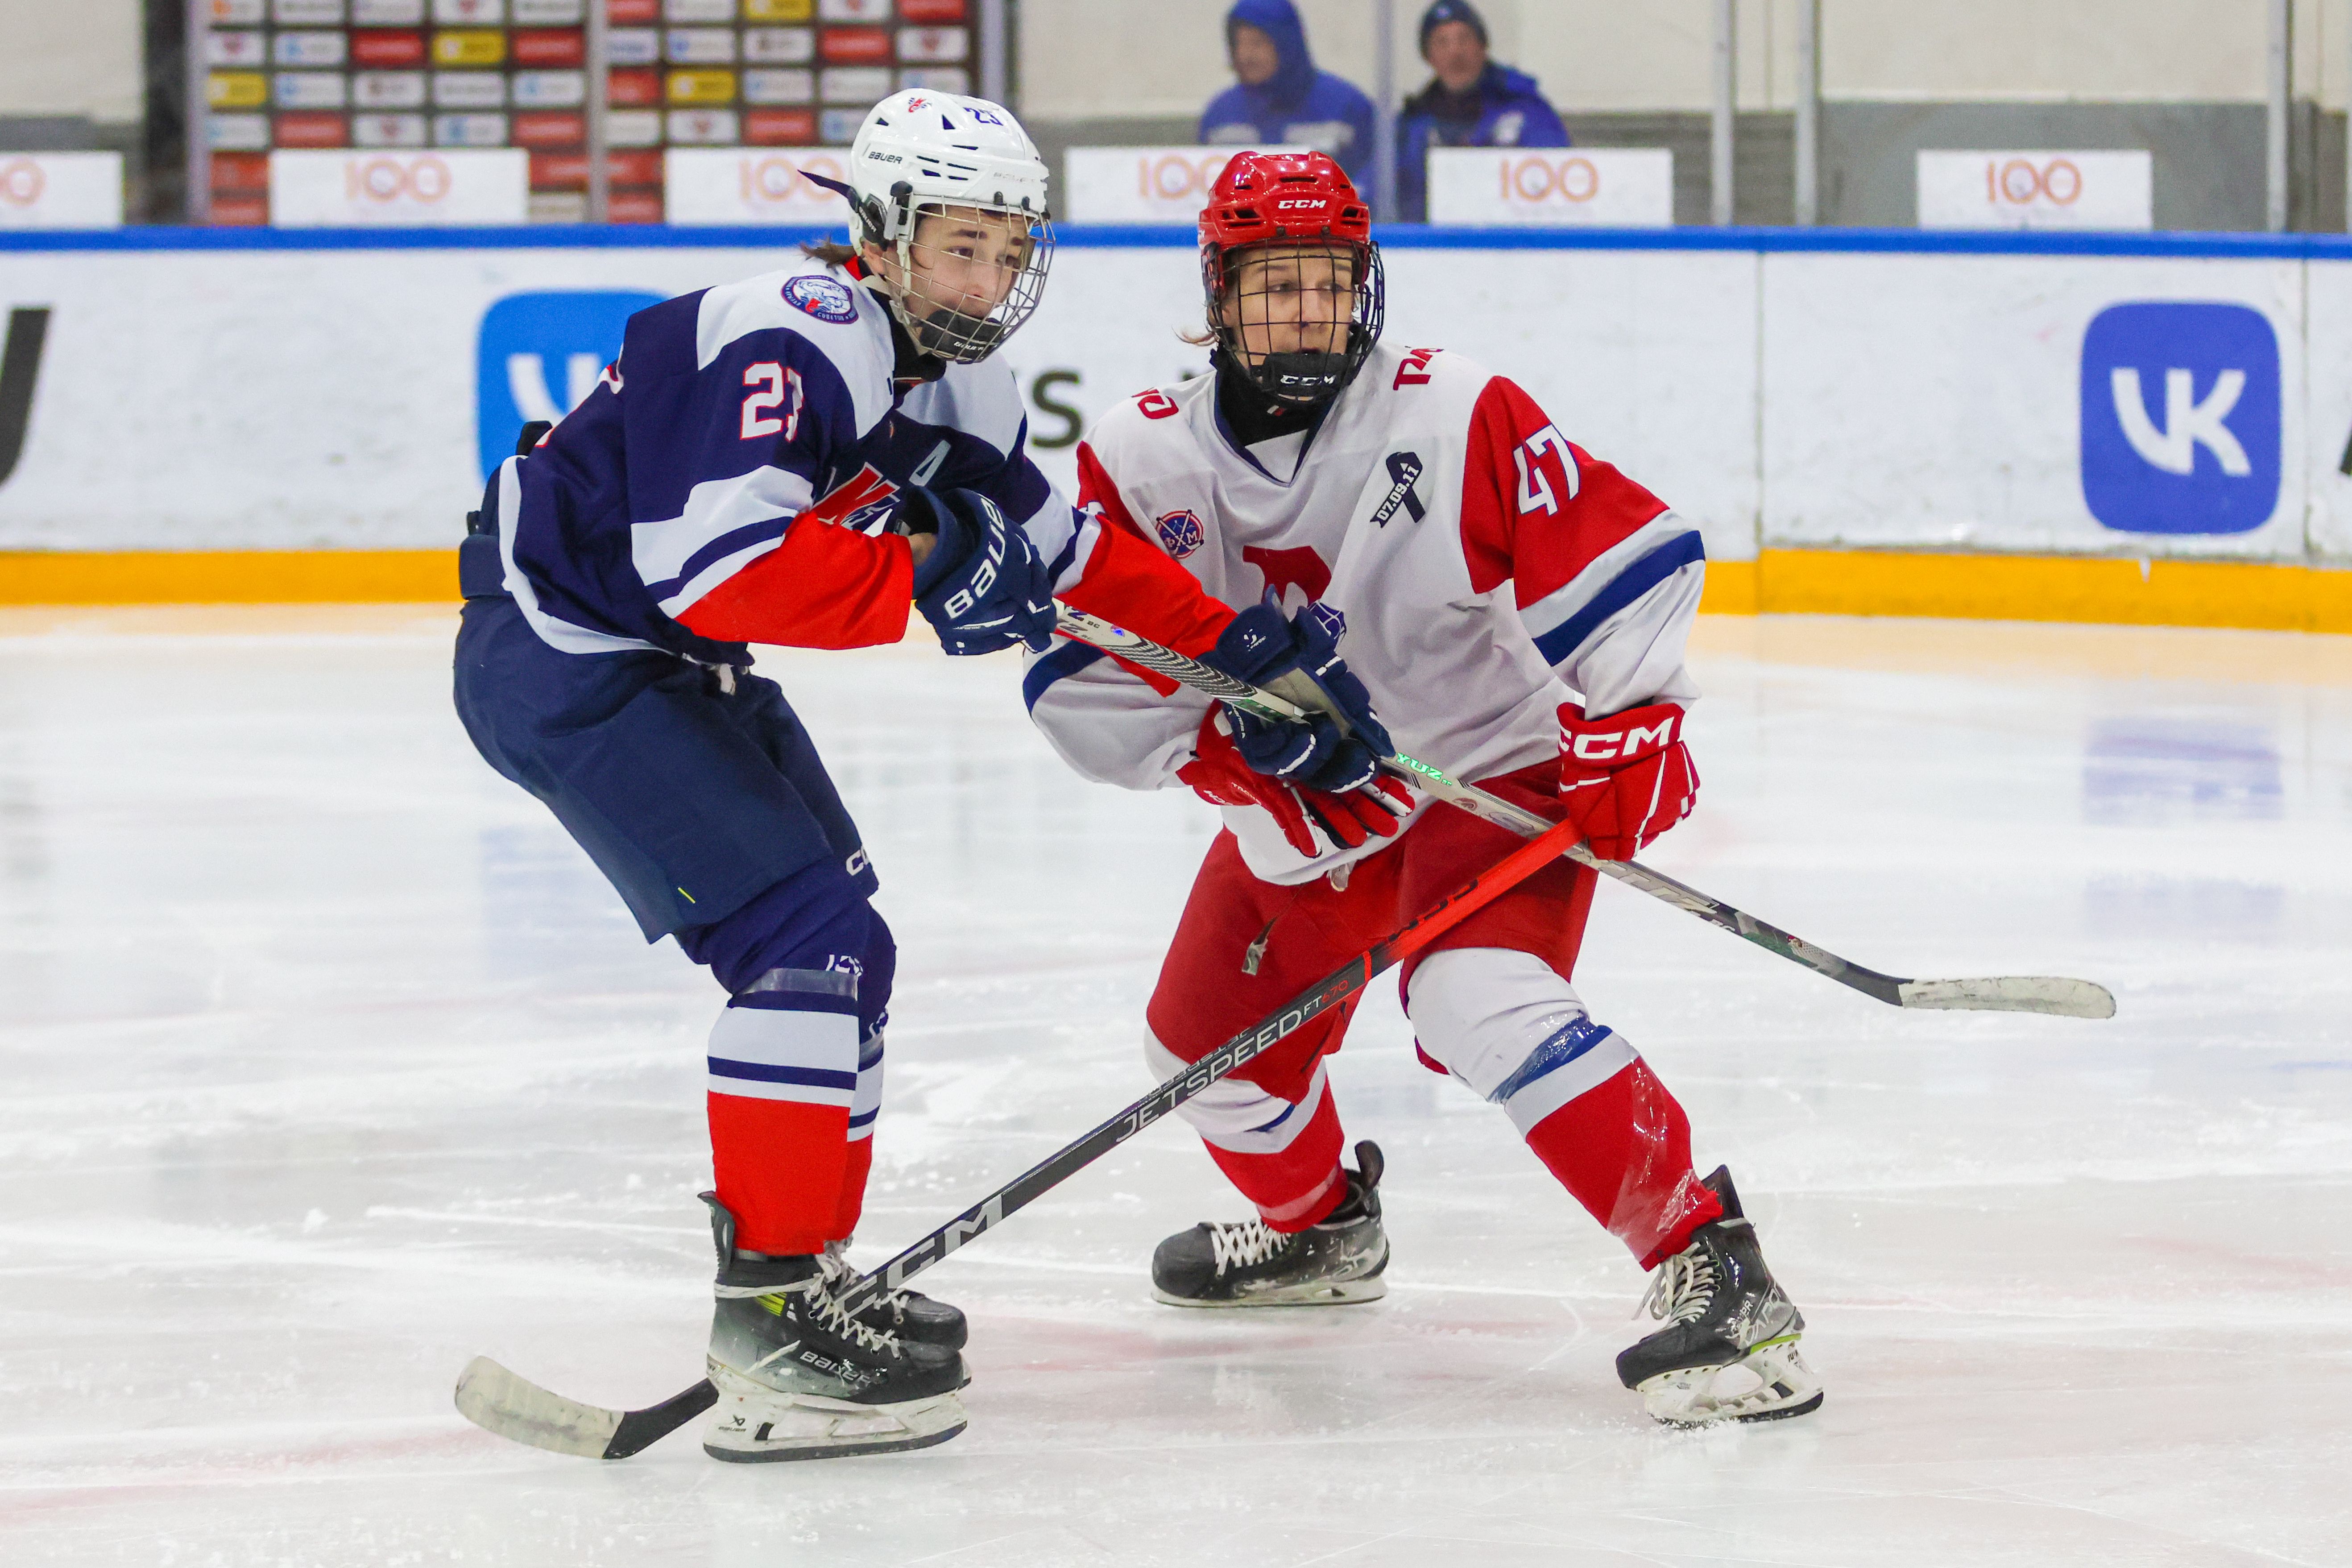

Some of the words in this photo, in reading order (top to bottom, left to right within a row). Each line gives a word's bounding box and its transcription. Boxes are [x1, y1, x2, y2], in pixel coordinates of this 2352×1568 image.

[963, 107, 1003, 126] 23
[868, 150, 903, 165] BAUER
[1499, 156, 1600, 202] 100
[1278, 199, 1327, 209] CCM
[1987, 160, 2083, 205] 100
[1280, 374, 1337, 386] CCM
[2111, 368, 2251, 477] VK
[1512, 423, 1580, 517] 47
[1376, 465, 1419, 521] 07.09.11
[1163, 530, 1198, 548] ФХМ
[1396, 753, 1443, 781] YUZ
[1116, 1009, 1302, 1143] JETSPEED
[832, 1194, 1003, 1319] CCM
